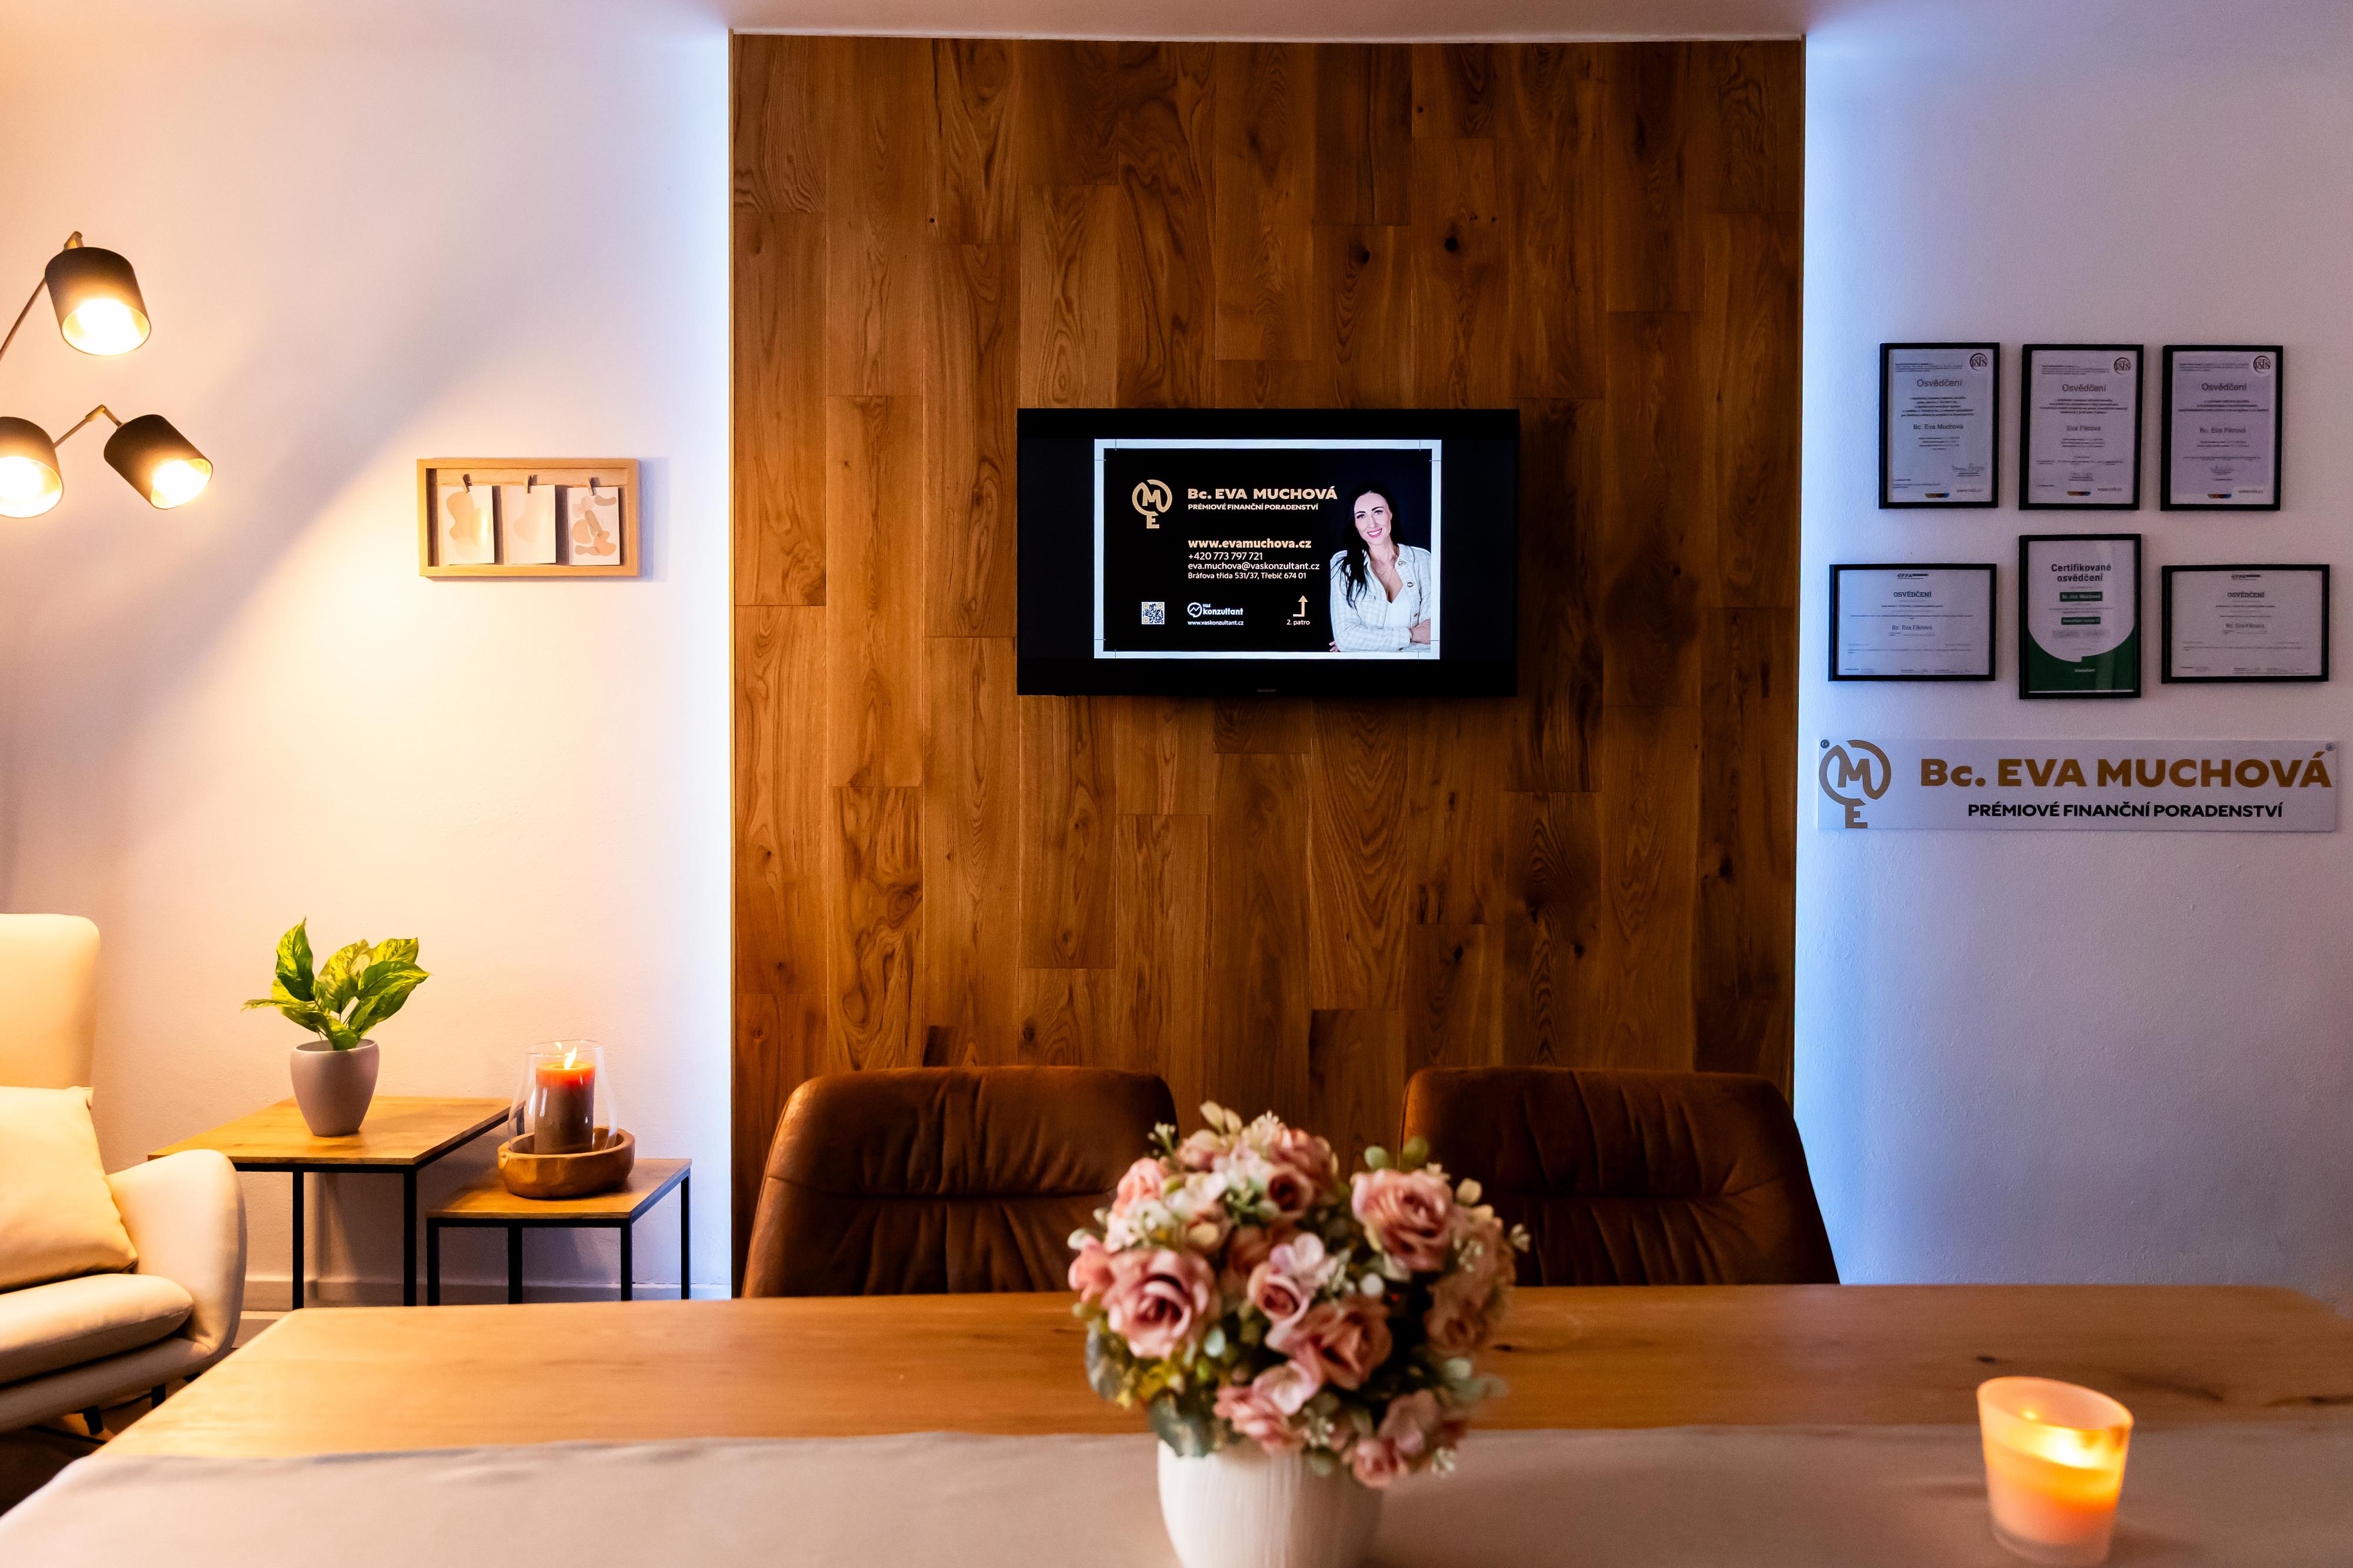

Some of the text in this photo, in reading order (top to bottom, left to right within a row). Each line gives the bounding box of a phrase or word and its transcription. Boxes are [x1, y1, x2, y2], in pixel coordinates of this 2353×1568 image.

[1917, 379, 1962, 387] Osvědčení
[2062, 383, 2107, 392] Osvědčení
[2201, 383, 2247, 391] Osvědčení
[1188, 486, 1338, 499] Bc. EVA MUCHOVÁ
[1188, 539, 1312, 548] www.evamuchova.cz
[1188, 562, 1320, 571] eva.muchova@vaskonzultant.cz
[2051, 563, 2112, 572] Certifikované
[2057, 573, 2103, 582] osvědčení
[1921, 751, 2332, 788] Bc. EVA MUCHOVÁ
[1968, 801, 2284, 818] PRÉMIOVÉ FINANČNÍ PORADENSTVÍ
